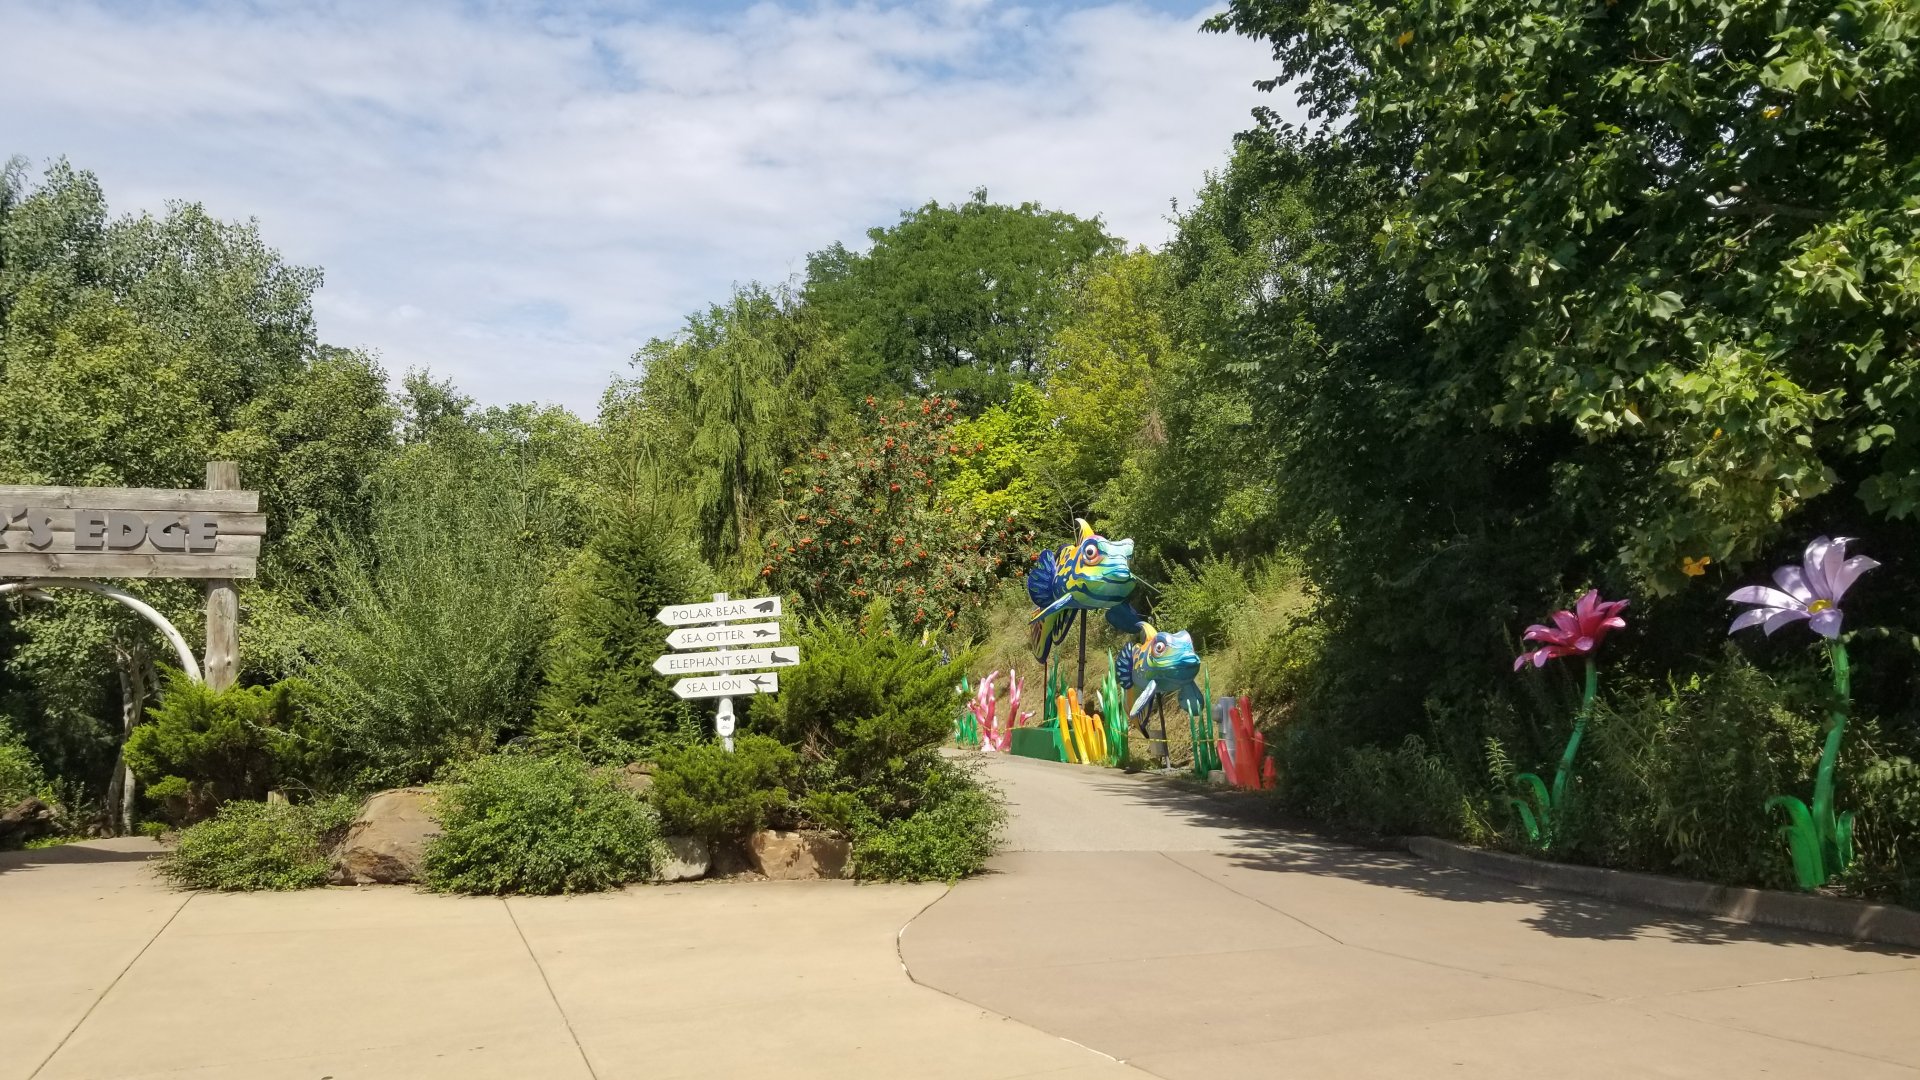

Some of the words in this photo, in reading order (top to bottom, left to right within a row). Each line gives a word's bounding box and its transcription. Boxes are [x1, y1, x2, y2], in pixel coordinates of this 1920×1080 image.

[0, 505, 53, 550] 'S
[75, 511, 219, 552] EDGE
[672, 607, 713, 620] POLAR
[716, 604, 747, 617] BEAR
[681, 634, 703, 644] SEA
[706, 630, 745, 642] OTTER
[670, 656, 732, 669] ELEPHANT
[735, 654, 763, 665] SEAL
[686, 682, 708, 693] SEA
[712, 680, 741, 691] LION
